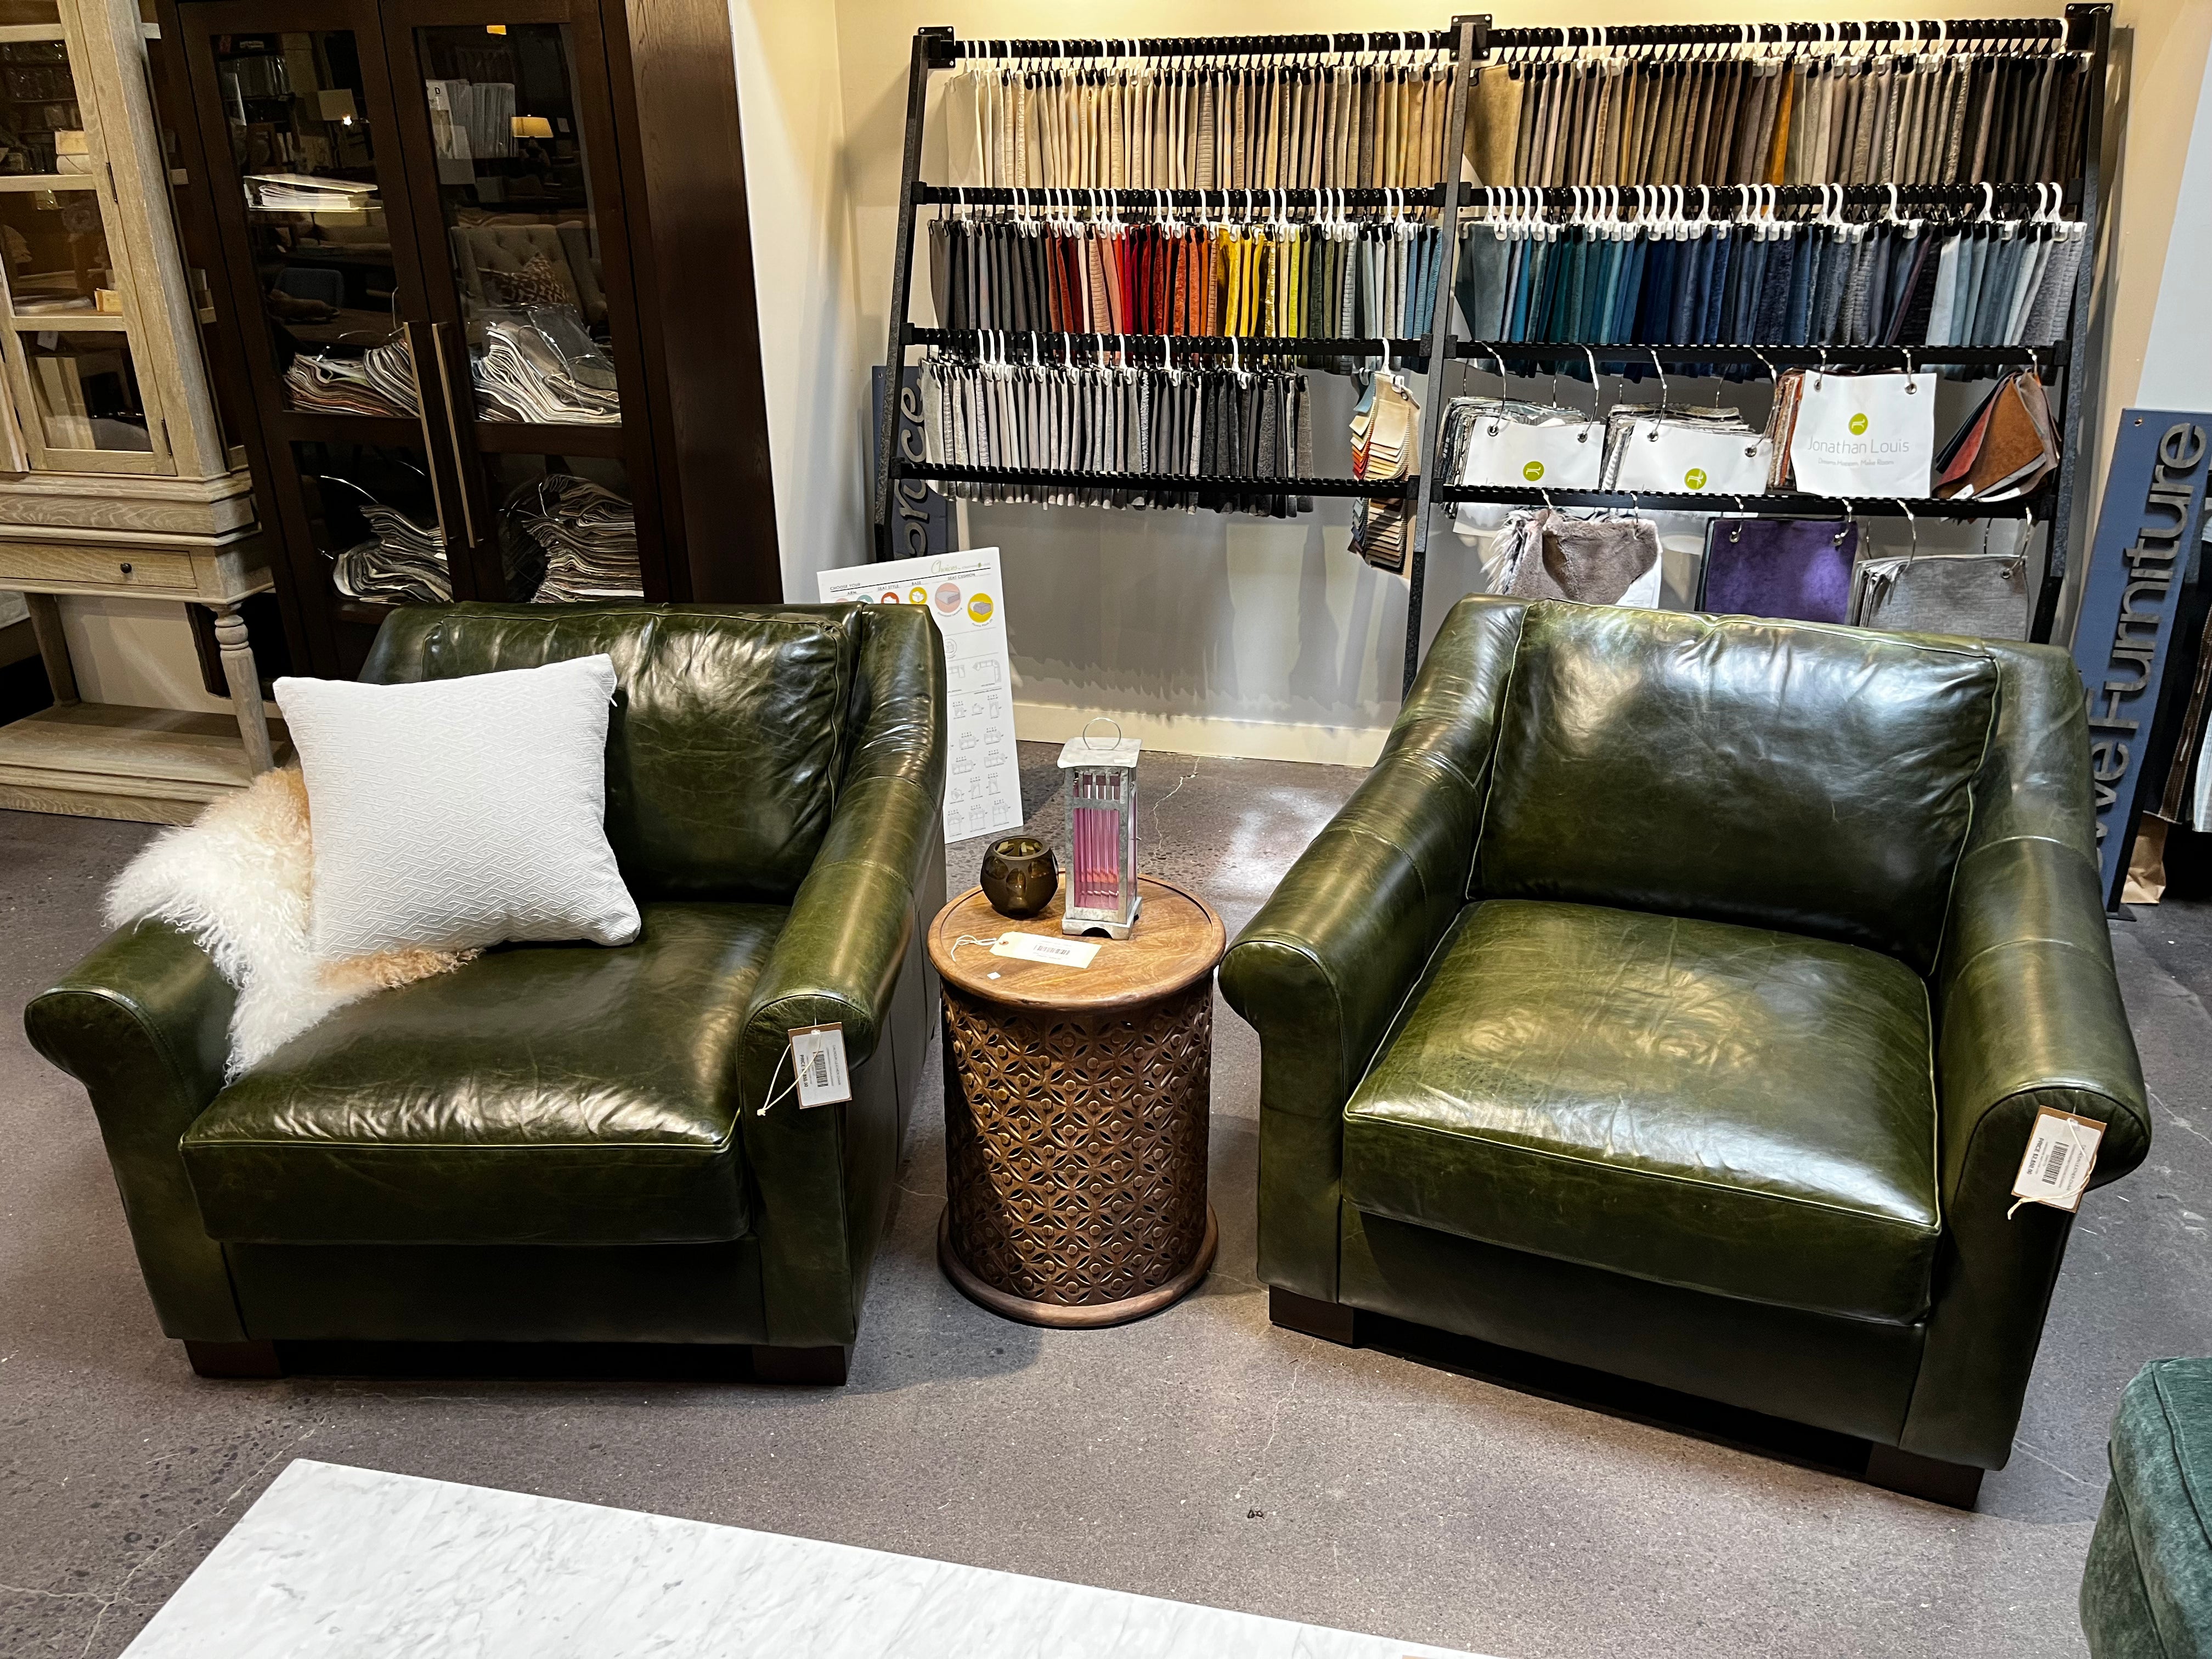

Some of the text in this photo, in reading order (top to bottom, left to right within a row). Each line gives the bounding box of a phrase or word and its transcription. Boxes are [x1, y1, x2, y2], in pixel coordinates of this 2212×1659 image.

[1808, 436, 1910, 454] Jonathan Louis
[931, 559, 957, 574] Choices
[2086, 422, 2208, 730] Furniture
[2034, 1137, 2044, 1153] PRICE
